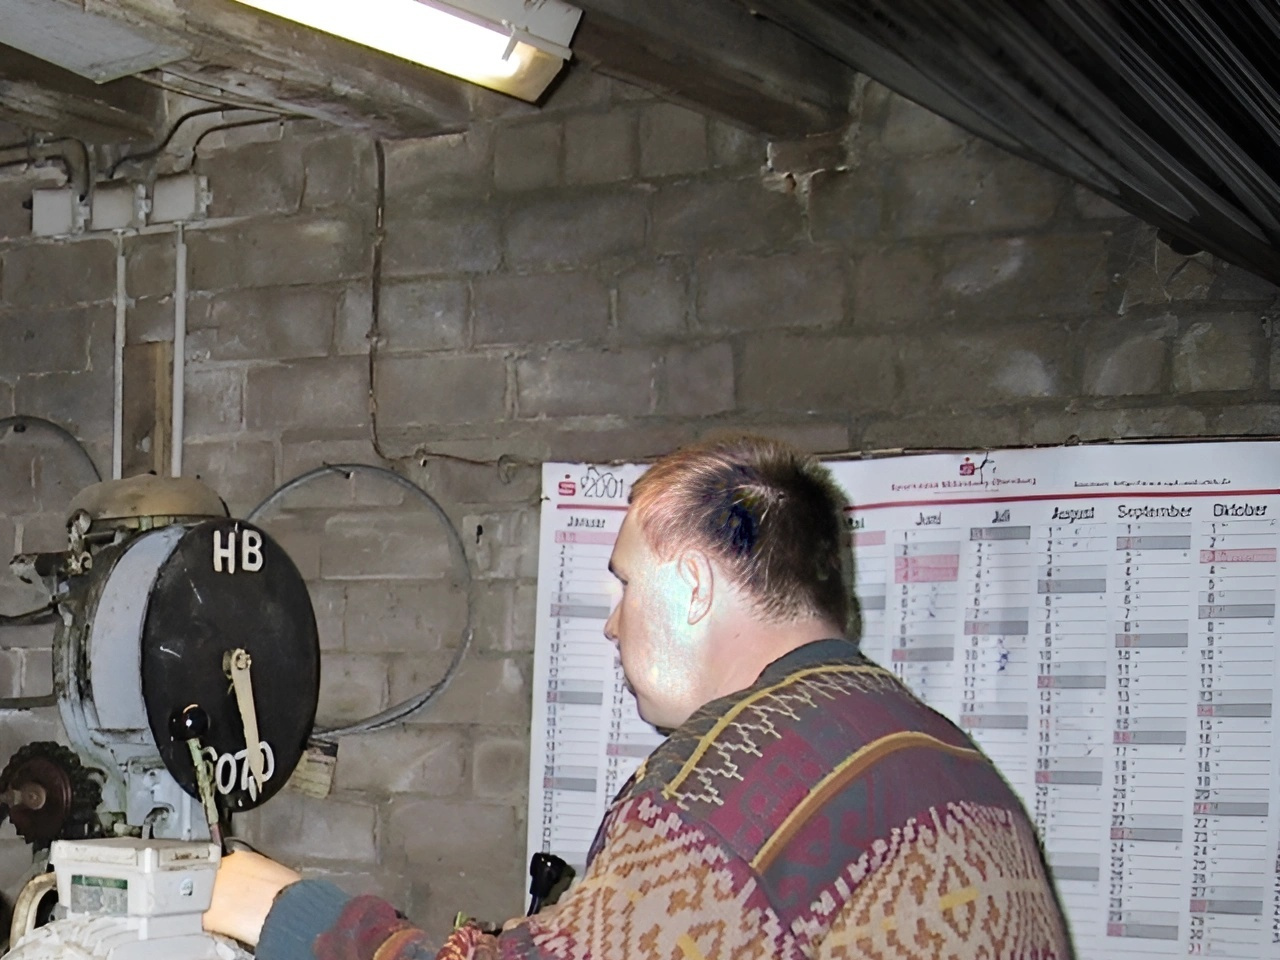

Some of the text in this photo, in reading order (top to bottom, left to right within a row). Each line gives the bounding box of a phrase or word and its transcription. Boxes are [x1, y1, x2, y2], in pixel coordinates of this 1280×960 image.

[1117, 503, 1193, 520] September
[1213, 503, 1268, 518] Oktober
[213, 529, 263, 574] HB
